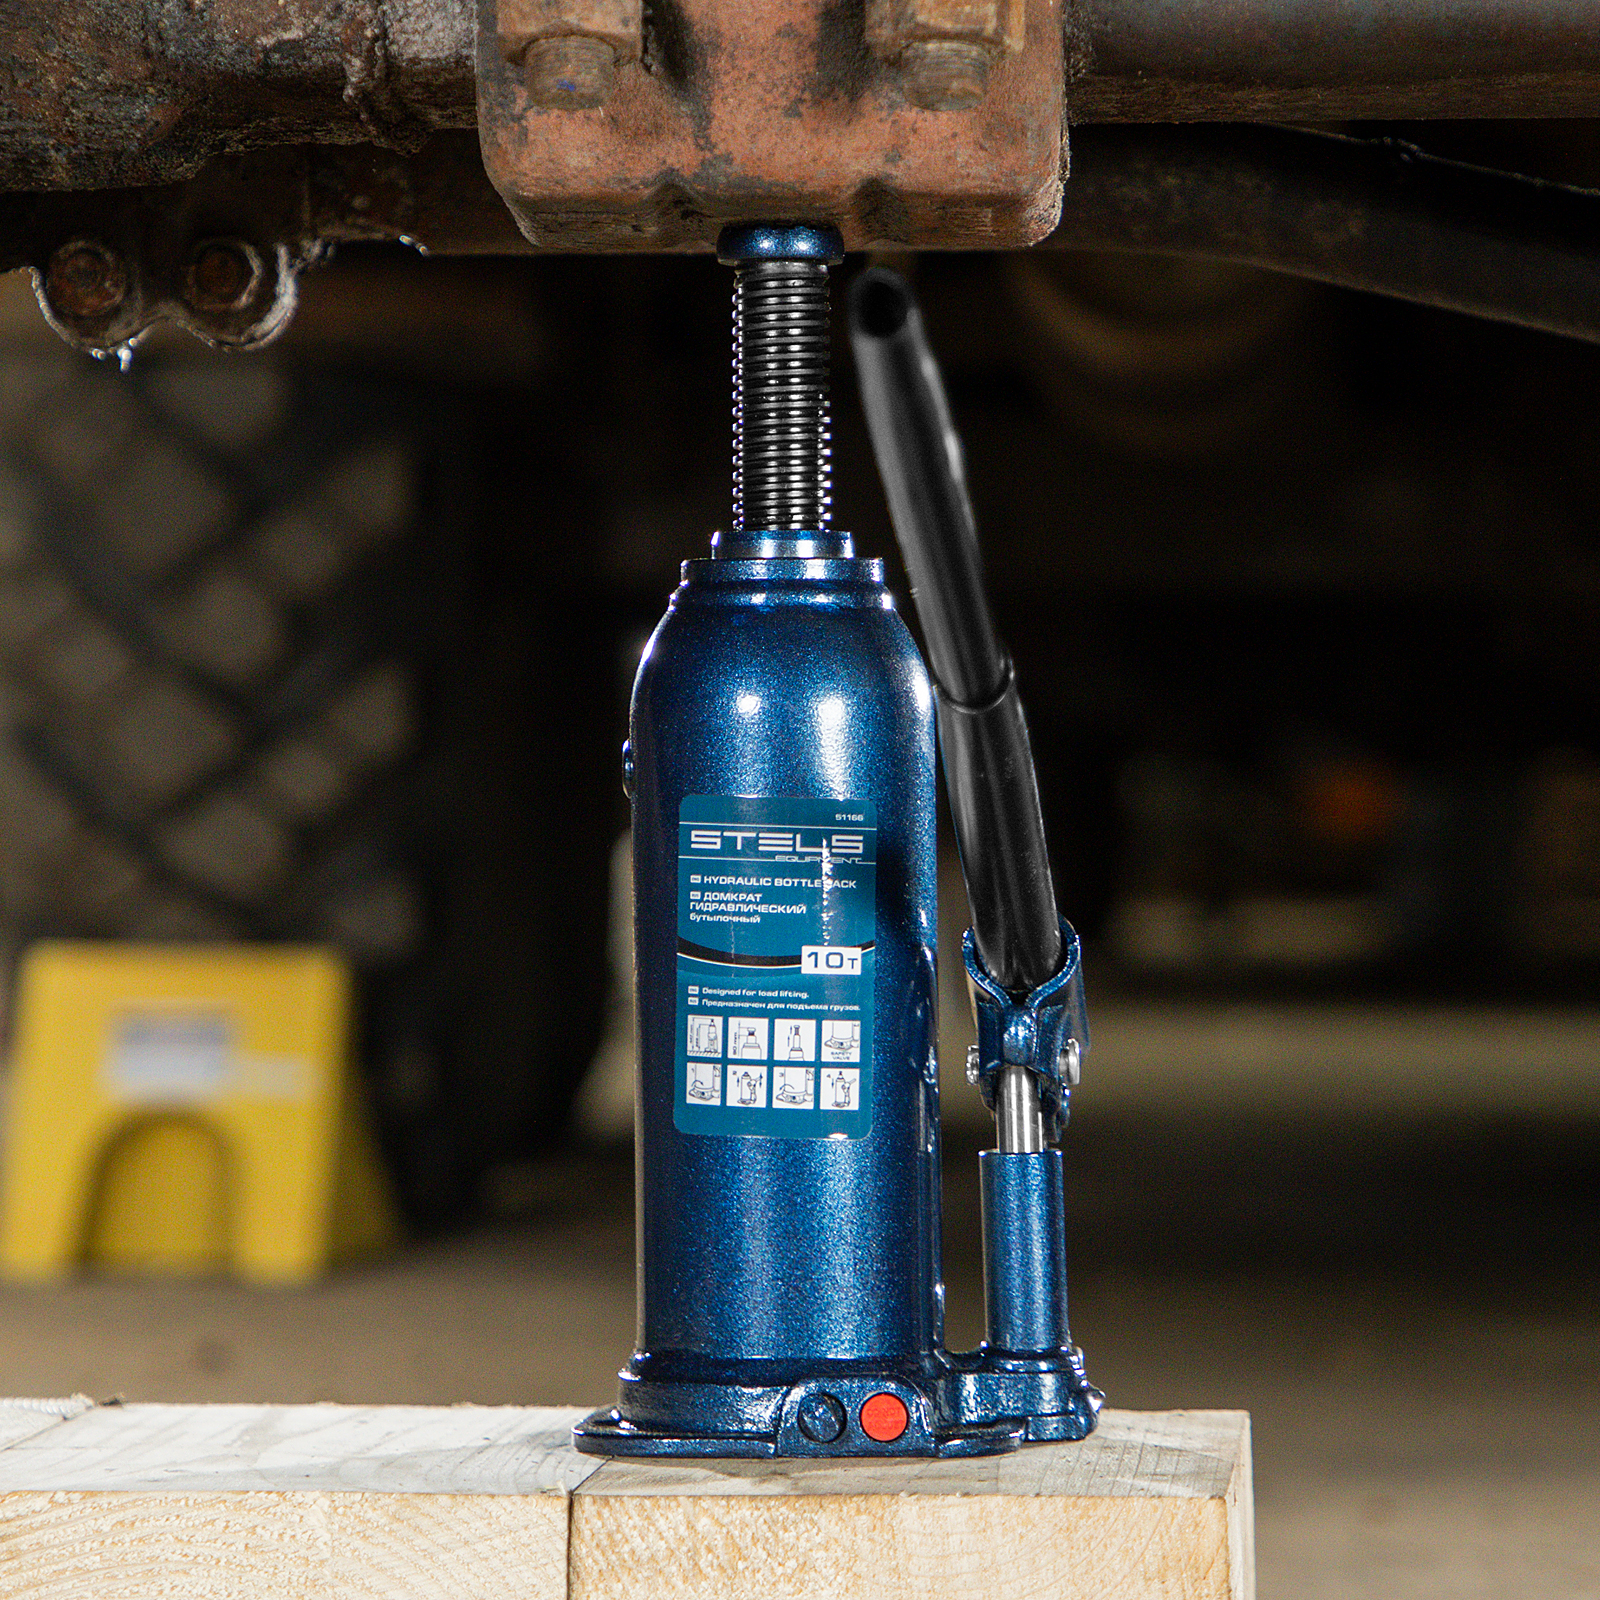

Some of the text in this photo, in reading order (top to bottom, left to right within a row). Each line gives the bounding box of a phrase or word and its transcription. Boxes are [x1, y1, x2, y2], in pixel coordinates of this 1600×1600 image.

[835, 813, 864, 821] 51166
[691, 830, 863, 854] STELS
[704, 875, 772, 886] HYDRAULIC
[774, 878, 822, 888] BOTTLE
[825, 879, 856, 888] ACK
[703, 892, 763, 902] ДОМКРАТ
[690, 902, 807, 914] ГИДРАВЛИЧЕСКИЙ
[690, 912, 761, 923] бутылочный
[702, 987, 740, 996] Designed
[742, 988, 756, 996] for
[758, 989, 778, 997] load
[779, 990, 809, 999] lifting.
[702, 999, 766, 1007] Предназначен
